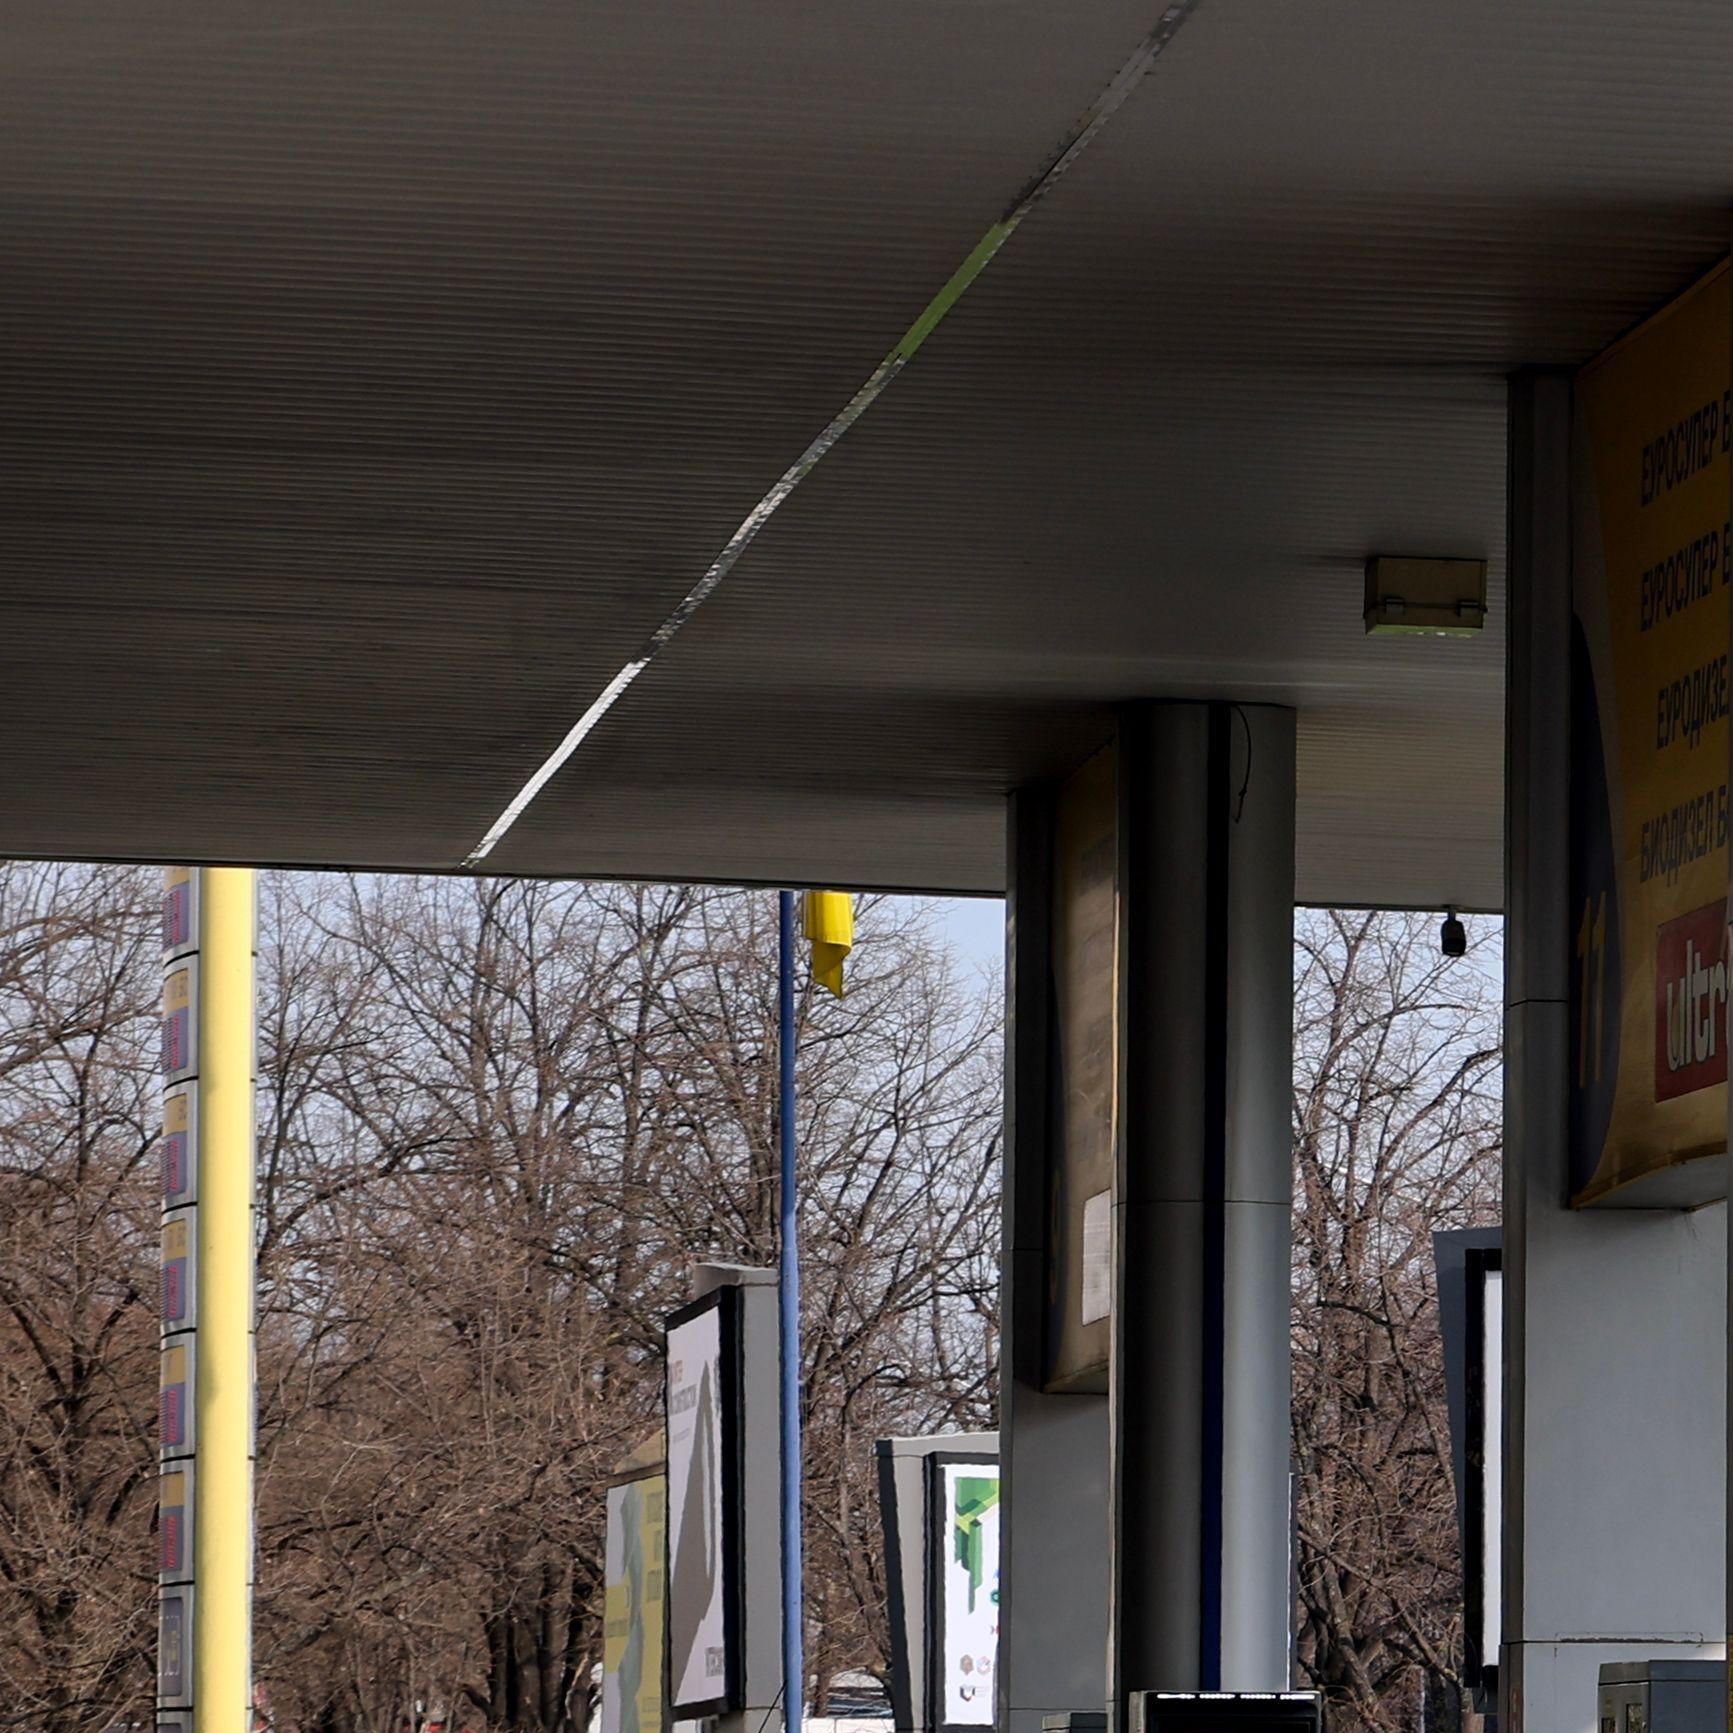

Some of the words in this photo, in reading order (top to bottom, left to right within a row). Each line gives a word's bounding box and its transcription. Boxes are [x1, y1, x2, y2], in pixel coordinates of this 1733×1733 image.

[1640, 402, 1718, 508] ЕУРОСУПЕР
[1640, 530, 1717, 633] ЕУРОСУПЕР
[1657, 654, 1730, 752] ЕУРОДИЗЕ
[1665, 939, 1727, 1073] ultr
